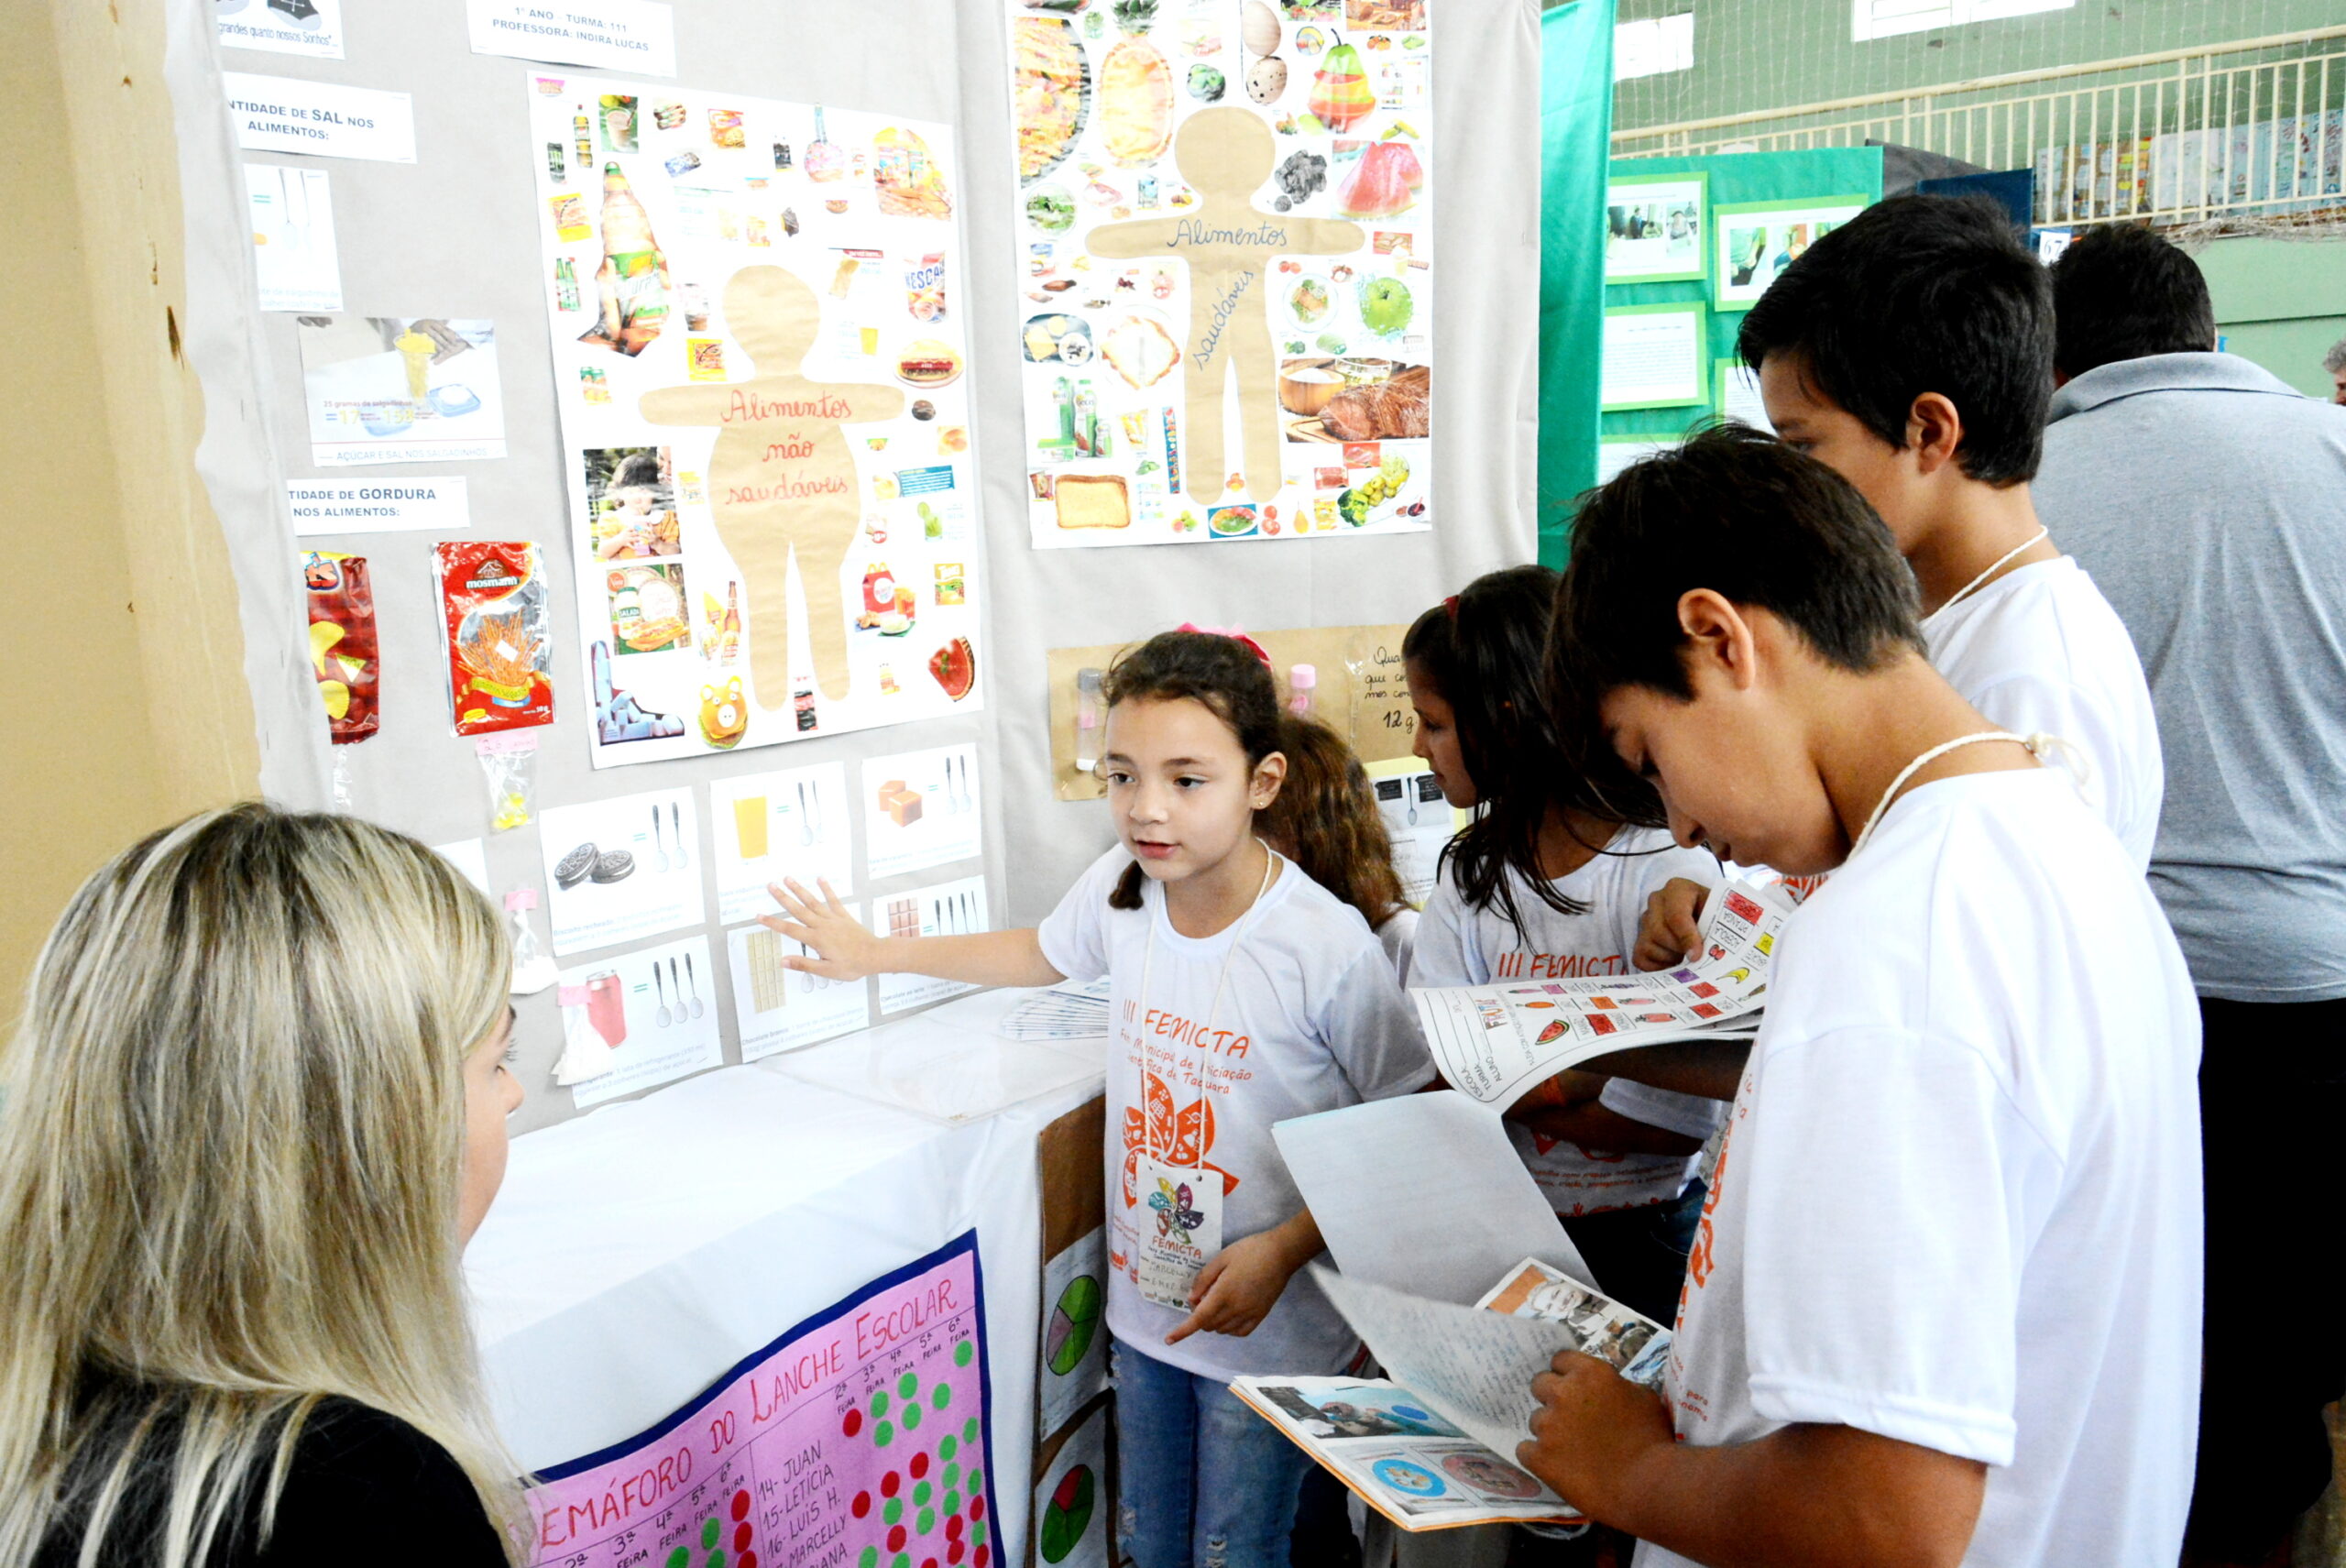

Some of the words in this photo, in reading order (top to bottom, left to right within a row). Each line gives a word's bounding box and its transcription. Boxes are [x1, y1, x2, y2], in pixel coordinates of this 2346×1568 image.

[219, 22, 247, 36] grandes
[250, 26, 274, 39] quanto
[276, 29, 301, 42] nossos
[529, 9, 554, 20] ANO
[566, 14, 607, 28] TURMA:
[610, 22, 627, 32] 111
[493, 18, 573, 38] PROFESSORA:
[576, 31, 612, 45] INDIRA
[615, 38, 649, 51] LUCAS
[247, 120, 330, 140] ALIMENTOS:
[291, 107, 308, 119] DE
[312, 109, 343, 125] SAL
[347, 116, 374, 129] NOS
[1167, 220, 1287, 248] Alimentos
[2045, 239, 2062, 256] 67
[1192, 270, 1254, 370] saudáveis
[721, 389, 851, 422] Alimentos
[336, 448, 376, 462] AÇÚCAR
[386, 450, 403, 458] SAL
[406, 449, 424, 457] NOS
[763, 434, 814, 461] não
[339, 490, 355, 500] DE
[359, 488, 436, 500] GORDURA
[726, 471, 848, 504] saudáveis
[293, 507, 320, 518] NOS
[324, 506, 400, 518] ALIMENTOS:
[1383, 710, 1402, 728] 12
[1146, 1009, 1250, 1058] FEMICTA
[1167, 1068, 1177, 1080] de
[1179, 1056, 1193, 1069] de
[1152, 1235, 1202, 1260] FEMICTA
[710, 1409, 735, 1454] DO
[750, 1341, 846, 1424] LANCHE
[856, 1278, 957, 1360] ESCOLAR
[784, 1439, 821, 1485] JUAN
[789, 1514, 847, 1568] MARCELLY
